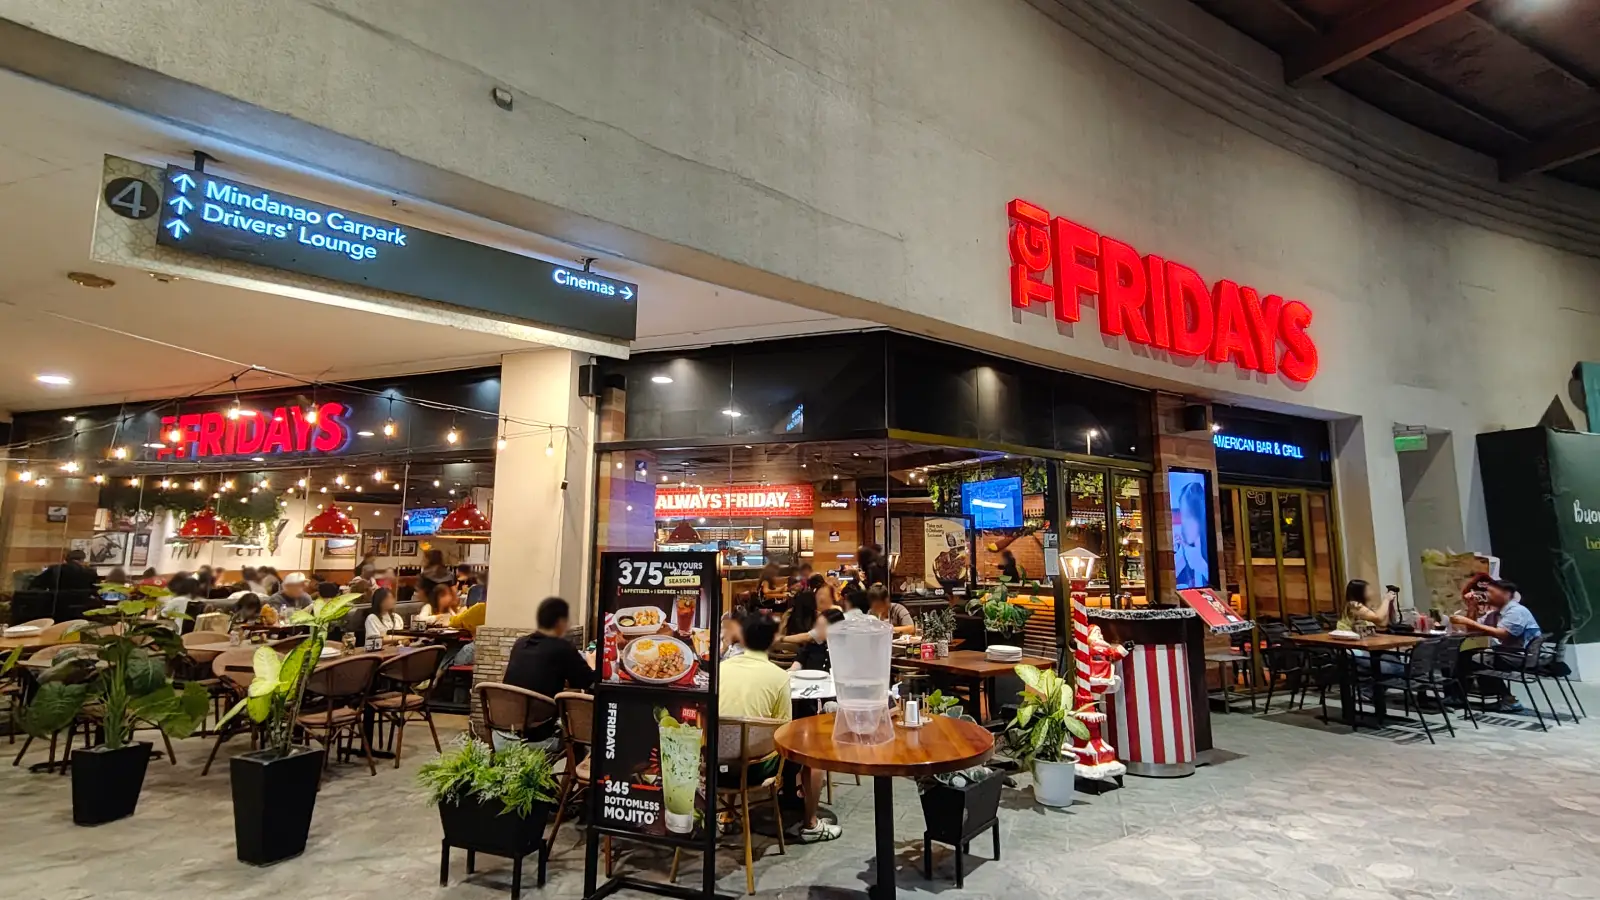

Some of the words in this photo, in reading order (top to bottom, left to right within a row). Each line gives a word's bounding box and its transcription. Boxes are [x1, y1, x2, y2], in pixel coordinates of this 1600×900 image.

[112, 181, 148, 218] 4
[205, 179, 322, 226] Mindanao
[326, 211, 408, 249] Carpark
[202, 201, 293, 240] Drivers'
[298, 226, 378, 261] Lounge
[552, 268, 616, 298] Cinemas
[1006, 198, 1053, 309] TGI
[1049, 215, 1320, 383] FRIDAYS
[176, 402, 345, 459] FRIDAYS
[1212, 433, 1255, 452] AMERICAN
[1256, 440, 1273, 455] BAR
[1273, 442, 1281, 456] &
[1282, 443, 1304, 459] GRILL
[654, 493, 723, 510] ALWAYS
[1573, 499, 1600, 525] Buo
[618, 561, 663, 586] 375
[663, 562, 677, 570] ALL
[677, 562, 703, 570] YOURS
[605, 709, 617, 760] FRIDAYS
[604, 779, 630, 796] 345
[603, 805, 656, 825] MOJITO
[604, 795, 660, 811] BOTTOMLESS
